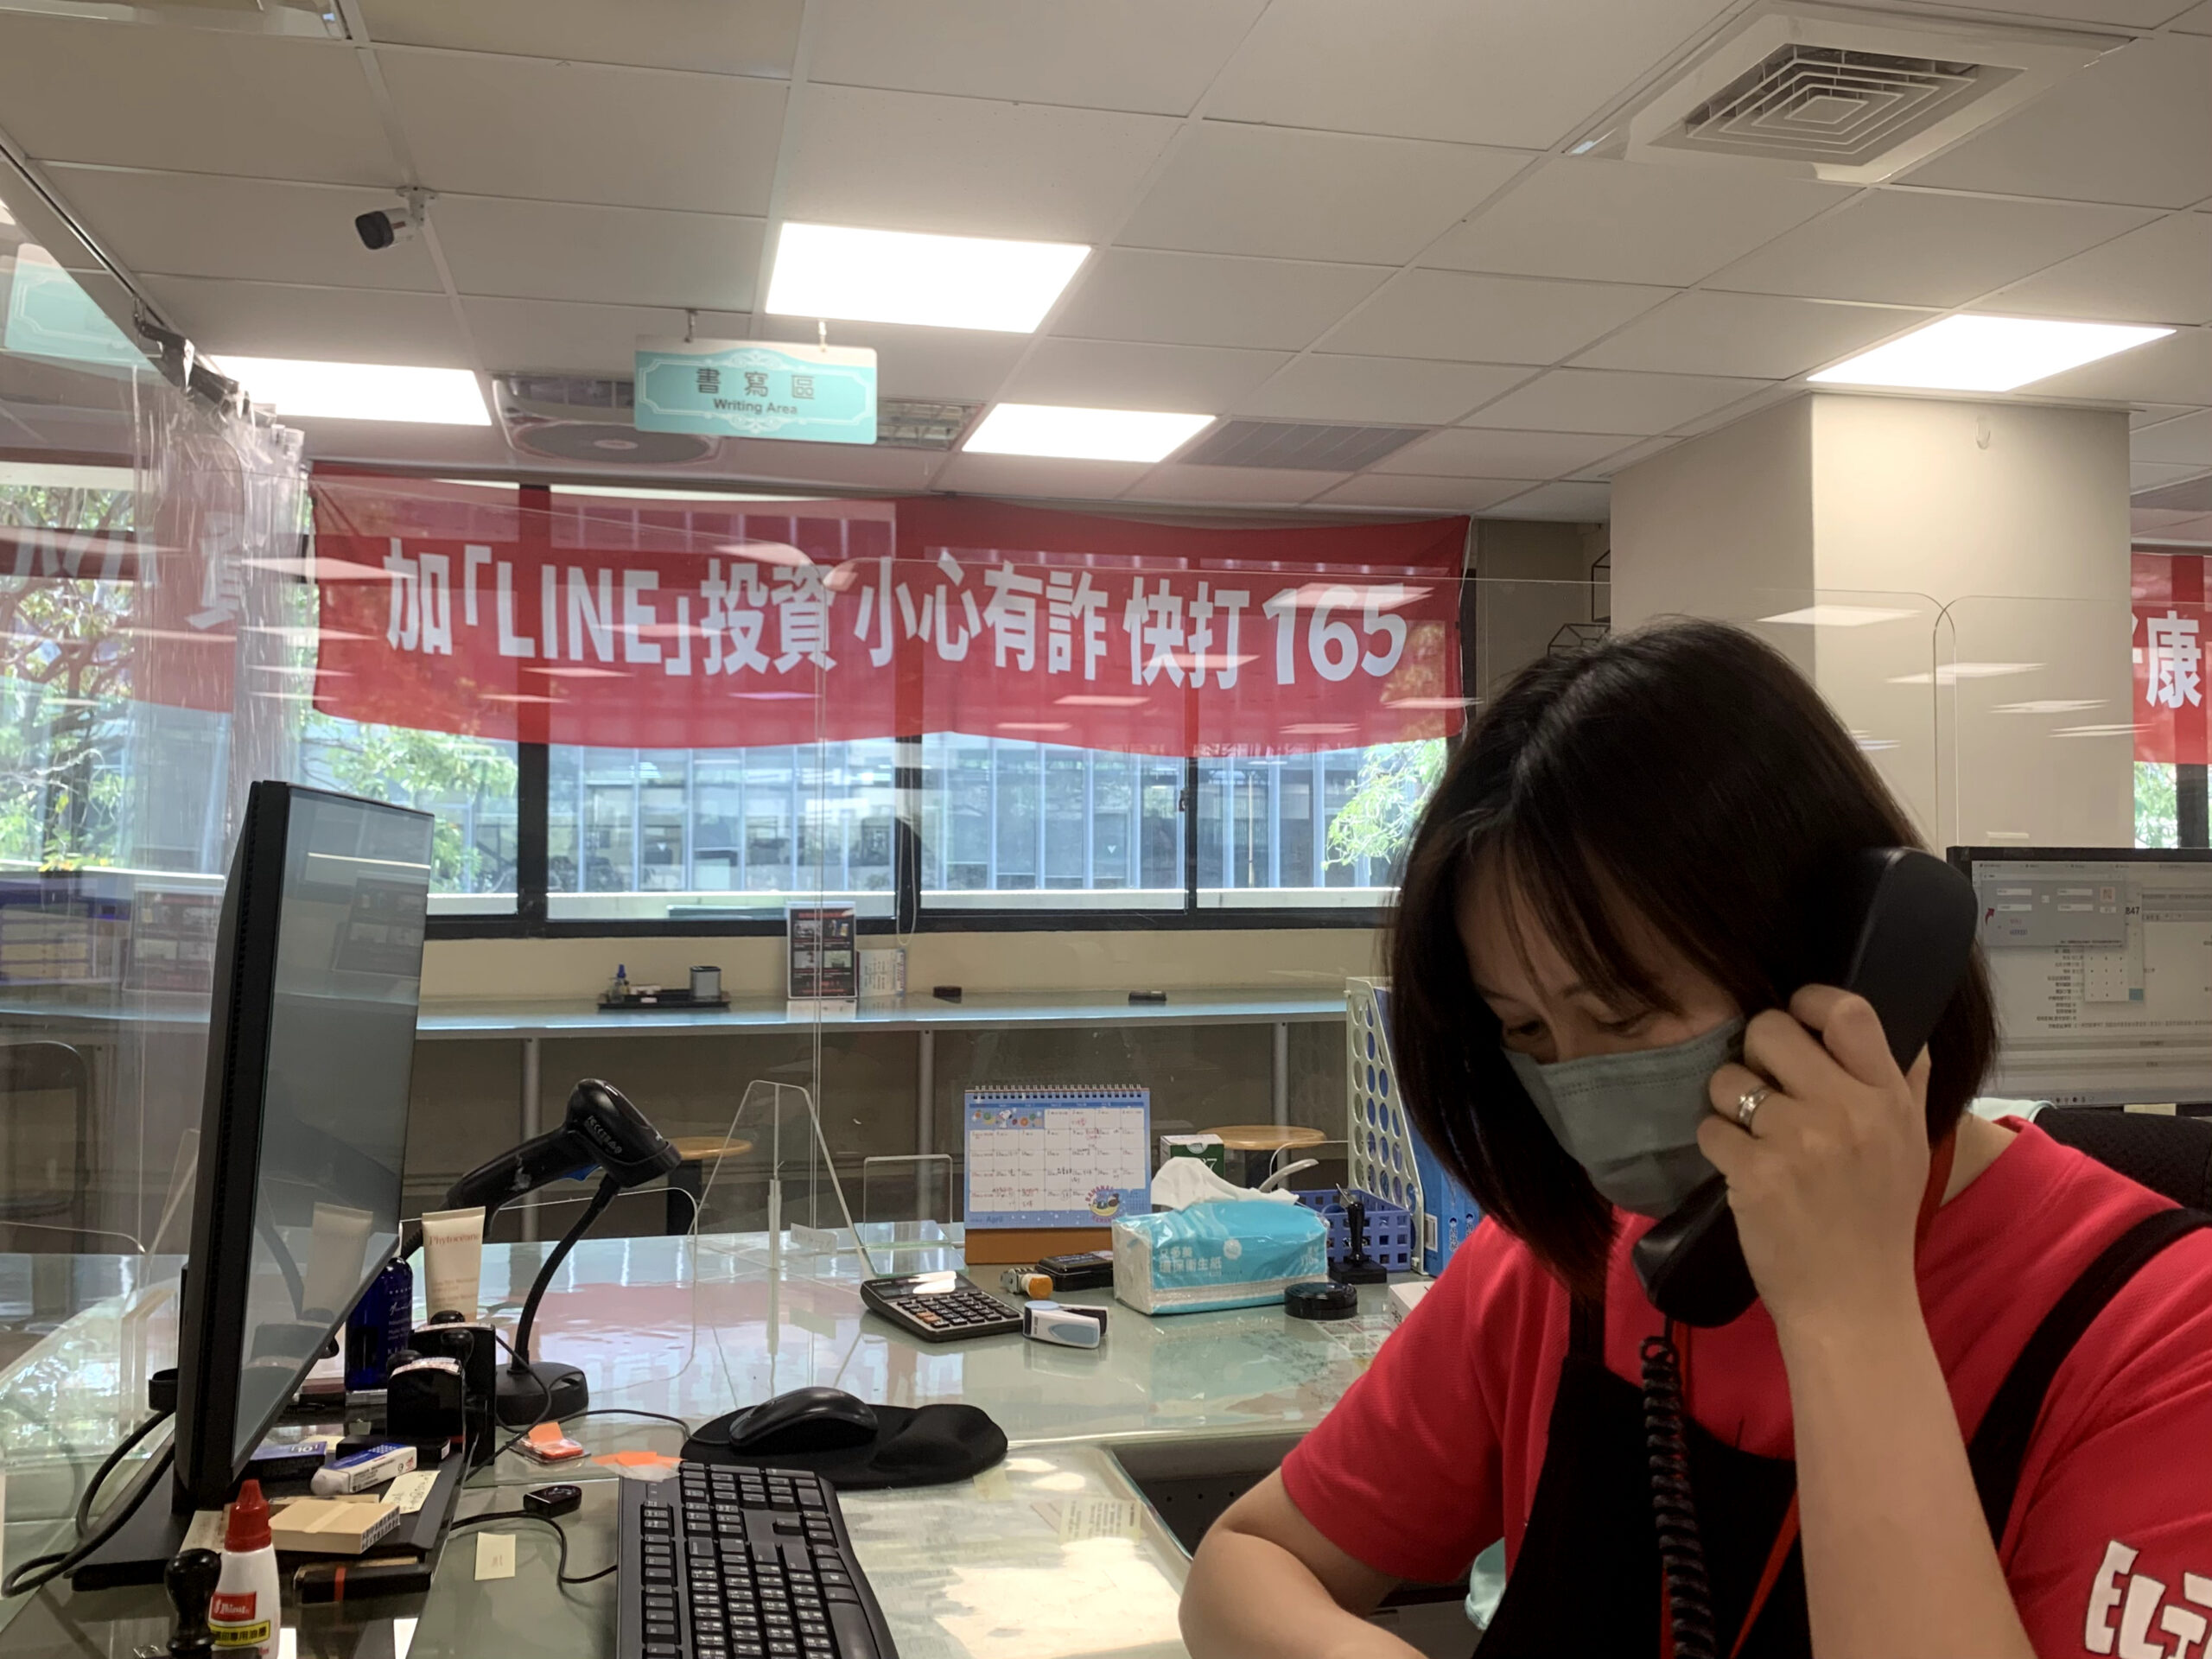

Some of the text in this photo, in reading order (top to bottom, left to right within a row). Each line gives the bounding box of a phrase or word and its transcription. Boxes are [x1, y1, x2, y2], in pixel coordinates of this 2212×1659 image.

[696, 367, 815, 400] 書寫區
[714, 398, 798, 415] Writing Area
[1262, 582, 1408, 685] 165
[2133, 610, 2202, 709] 康
